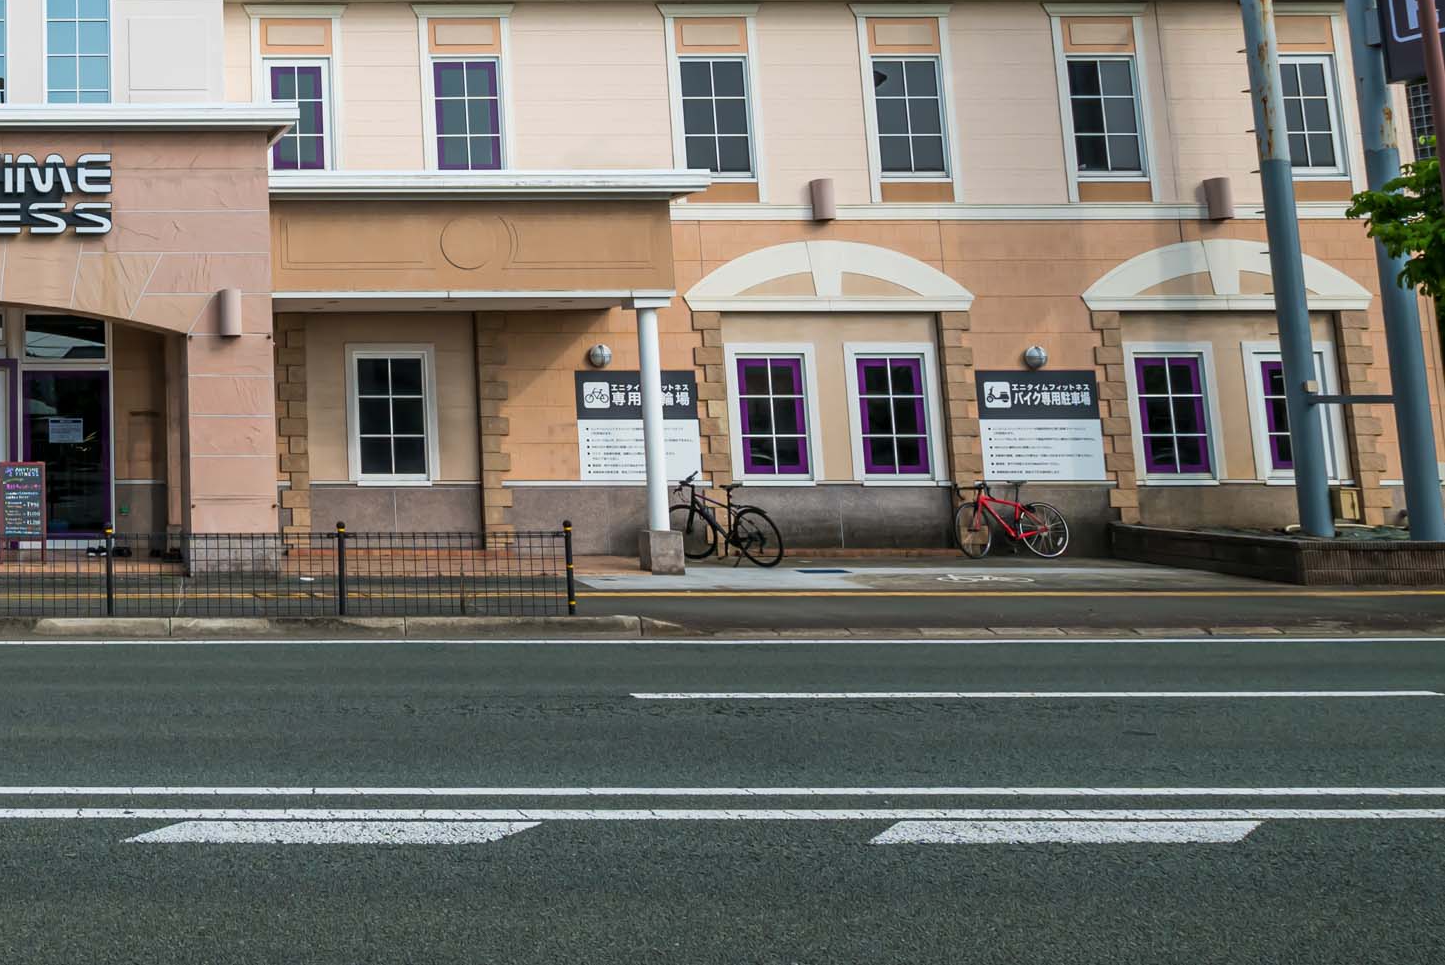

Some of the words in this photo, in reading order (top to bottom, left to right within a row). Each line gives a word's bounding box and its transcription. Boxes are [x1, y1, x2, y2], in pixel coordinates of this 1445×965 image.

[1011, 383, 1090, 391] エニタイムフィットネス
[612, 392, 690, 406] 専用輪場
[1014, 391, 1091, 406] バイク専用駐車場
